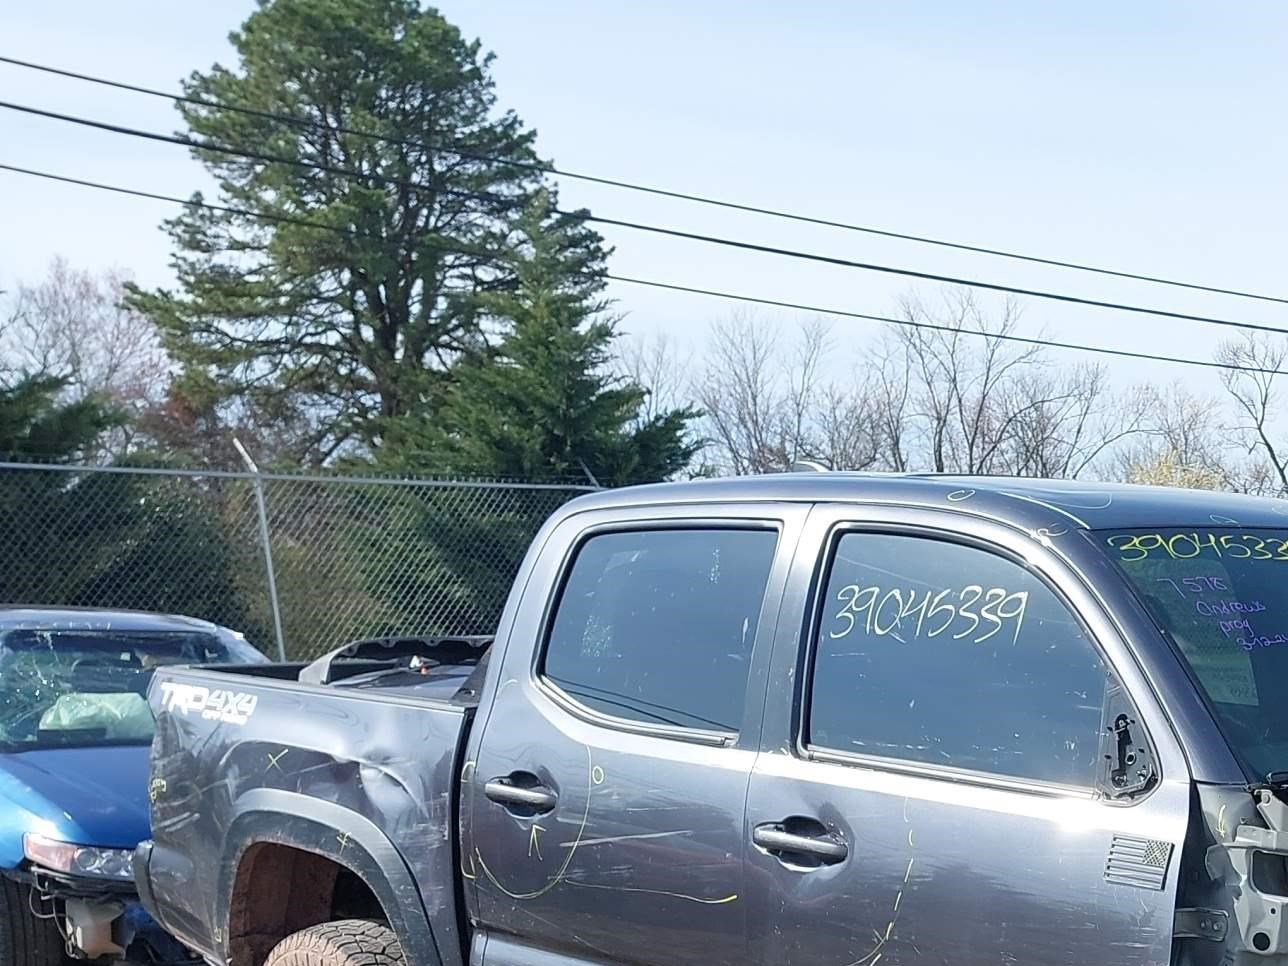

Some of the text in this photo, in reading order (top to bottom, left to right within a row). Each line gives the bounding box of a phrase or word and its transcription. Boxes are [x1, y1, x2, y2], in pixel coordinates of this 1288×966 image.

[1156, 576, 1228, 599] 7578
[830, 585, 1028, 645] 39045339
[160, 682, 211, 716] TRD
